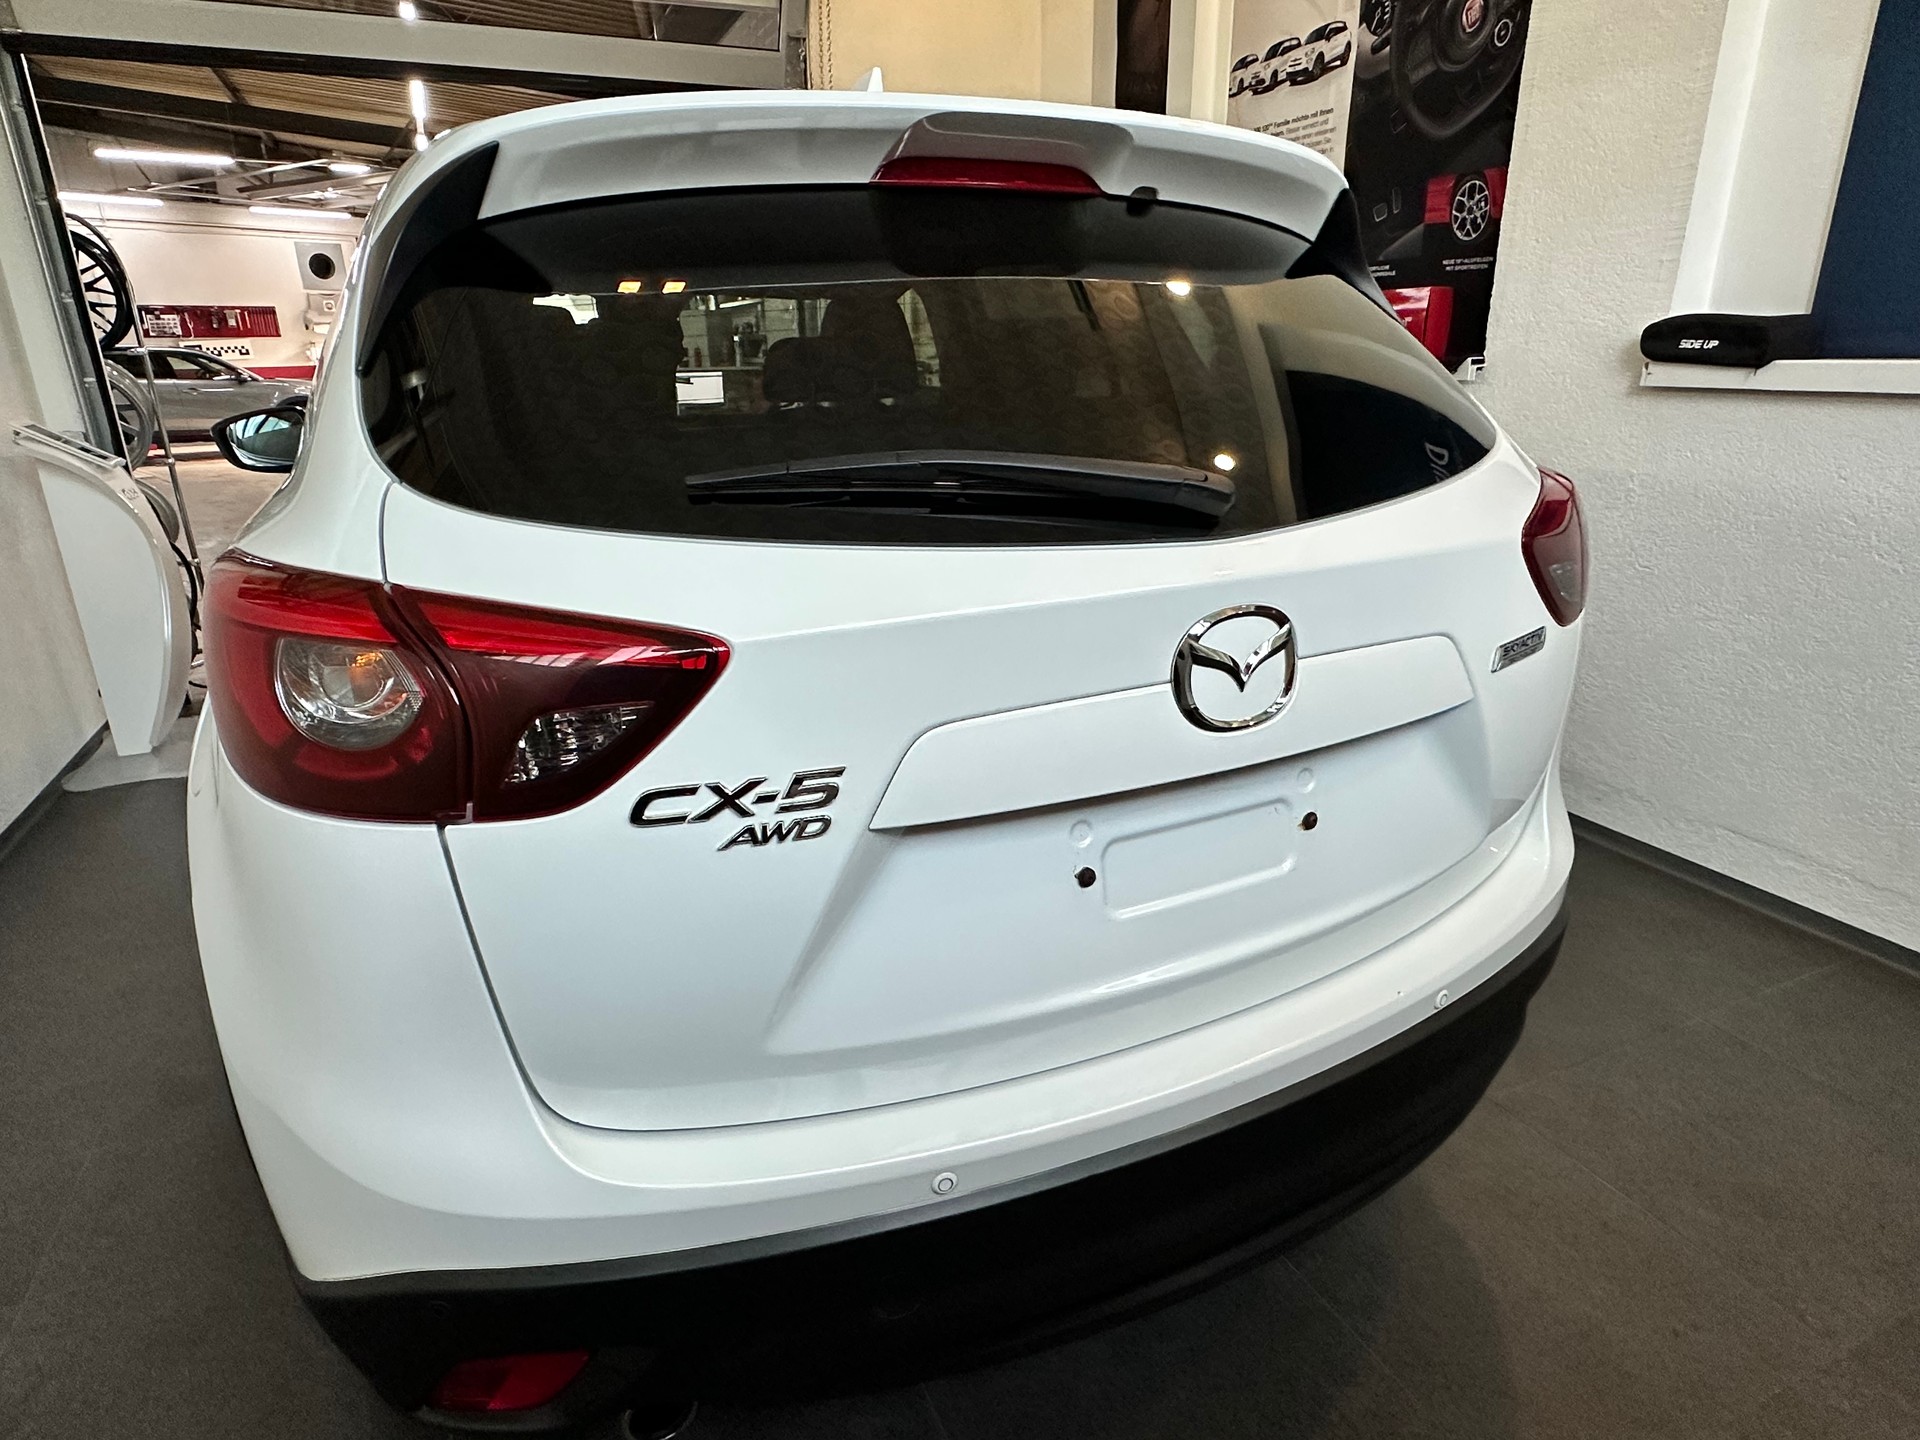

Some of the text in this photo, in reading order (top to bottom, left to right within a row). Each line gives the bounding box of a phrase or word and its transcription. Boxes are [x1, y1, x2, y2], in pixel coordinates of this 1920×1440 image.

[1292, 114, 1309, 123] möchte
[1319, 107, 1334, 116] Ihnen
[1678, 339, 1719, 349] SIDE UP
[627, 765, 847, 828] CX-5
[716, 814, 832, 852] AWD
